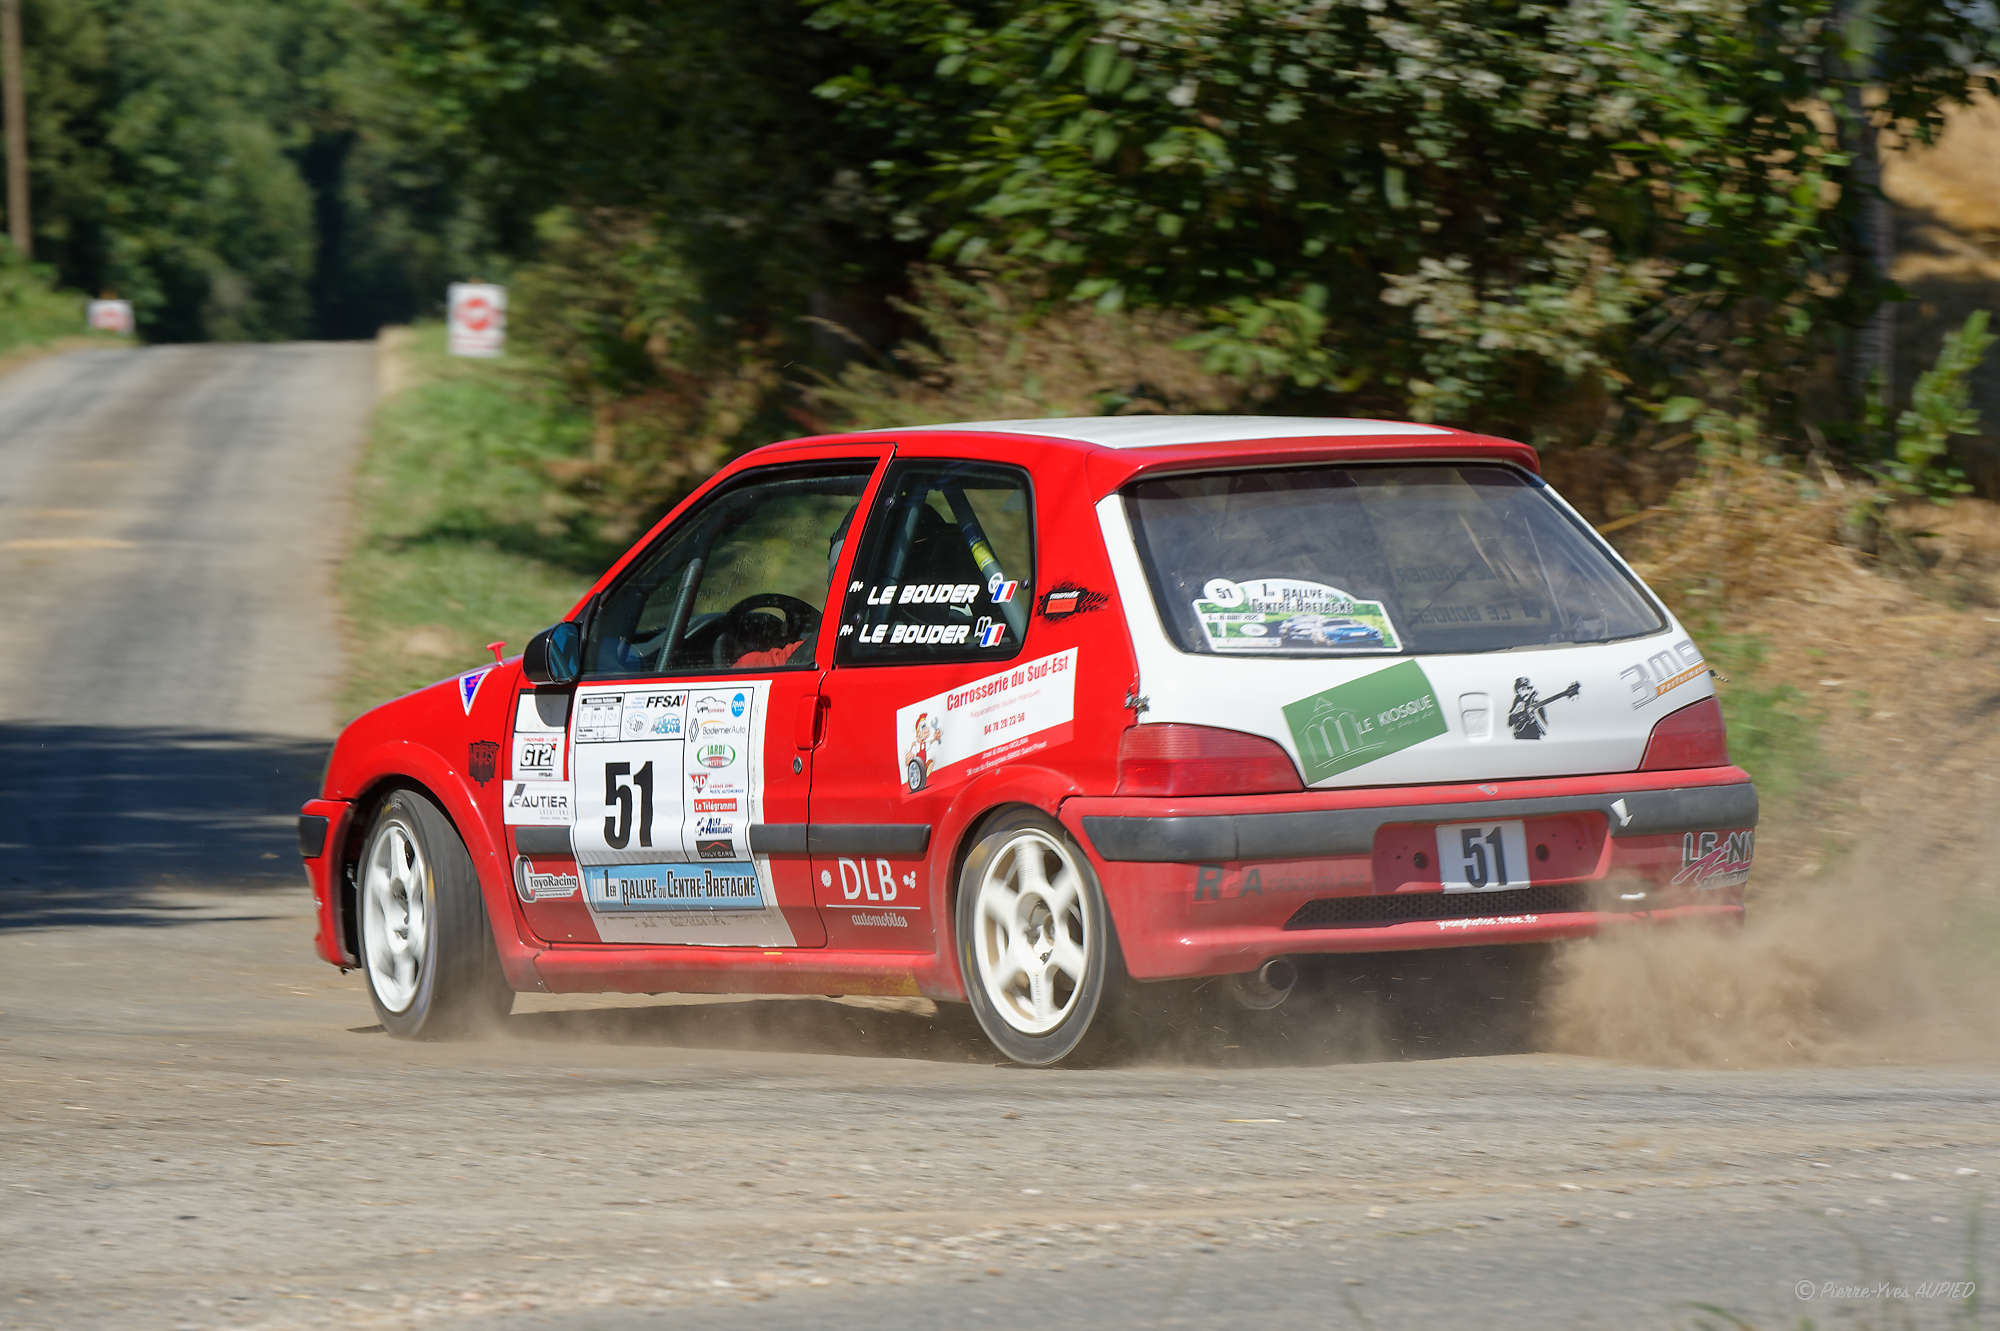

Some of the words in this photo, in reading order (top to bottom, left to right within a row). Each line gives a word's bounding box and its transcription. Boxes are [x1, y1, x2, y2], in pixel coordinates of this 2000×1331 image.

[867, 586, 897, 605] LE
[898, 584, 980, 605] BOUDER
[1216, 587, 1234, 599] 51
[859, 624, 889, 644] LE
[890, 624, 971, 644] BOUDER
[947, 674, 1009, 712] Carrosserie
[1012, 670, 1025, 688] du
[1027, 655, 1069, 683] Sud-Est
[646, 695, 681, 708] FFSA
[1378, 694, 1433, 727] KIOSQUE
[604, 760, 654, 849] 51
[1461, 826, 1508, 888] 51
[529, 874, 577, 888] ToyoRacing
[620, 878, 657, 906] RALLYE
[666, 869, 756, 898] CENTRE-BRETAGNE
[838, 857, 897, 901] DLB
[851, 911, 908, 928] automobiles
